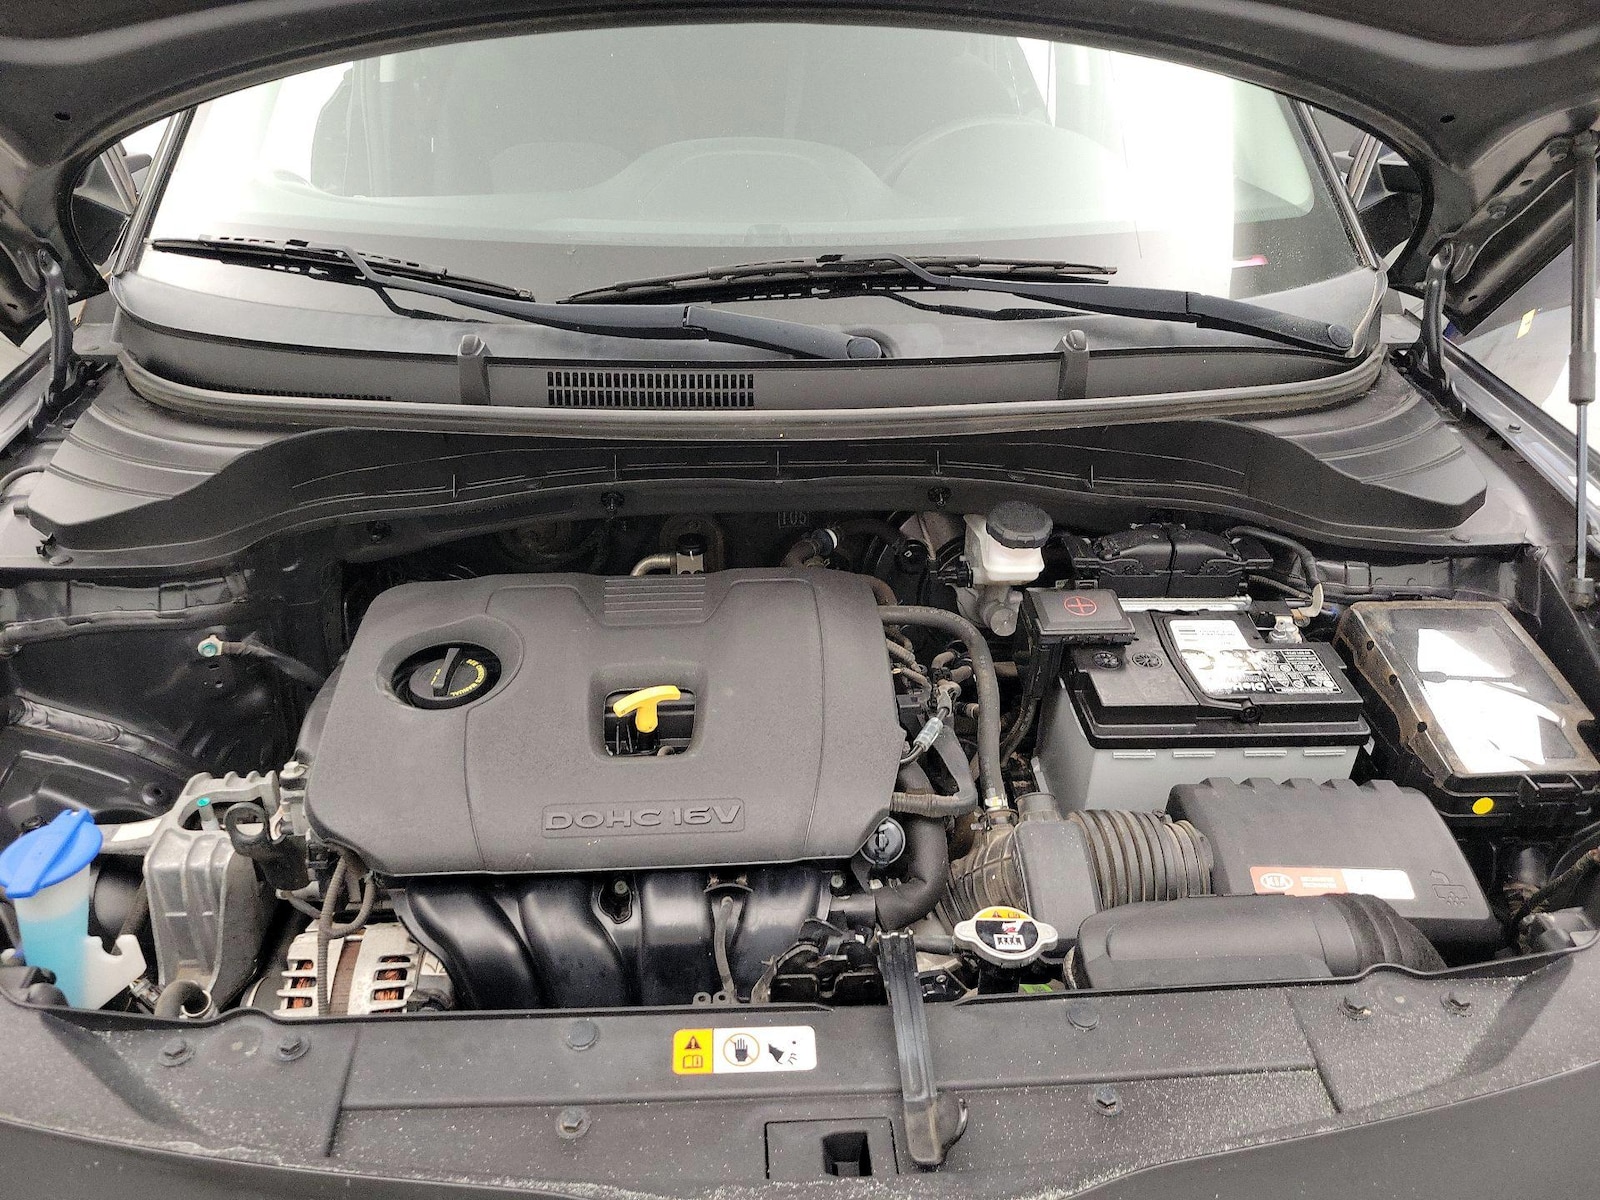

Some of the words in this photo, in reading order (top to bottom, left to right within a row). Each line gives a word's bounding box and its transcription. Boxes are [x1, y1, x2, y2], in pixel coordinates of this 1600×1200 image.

[450, 682, 478, 697] MANUAL
[545, 809, 662, 831] DOHC
[672, 805, 741, 826] 16V
[1263, 874, 1291, 888] KIA
